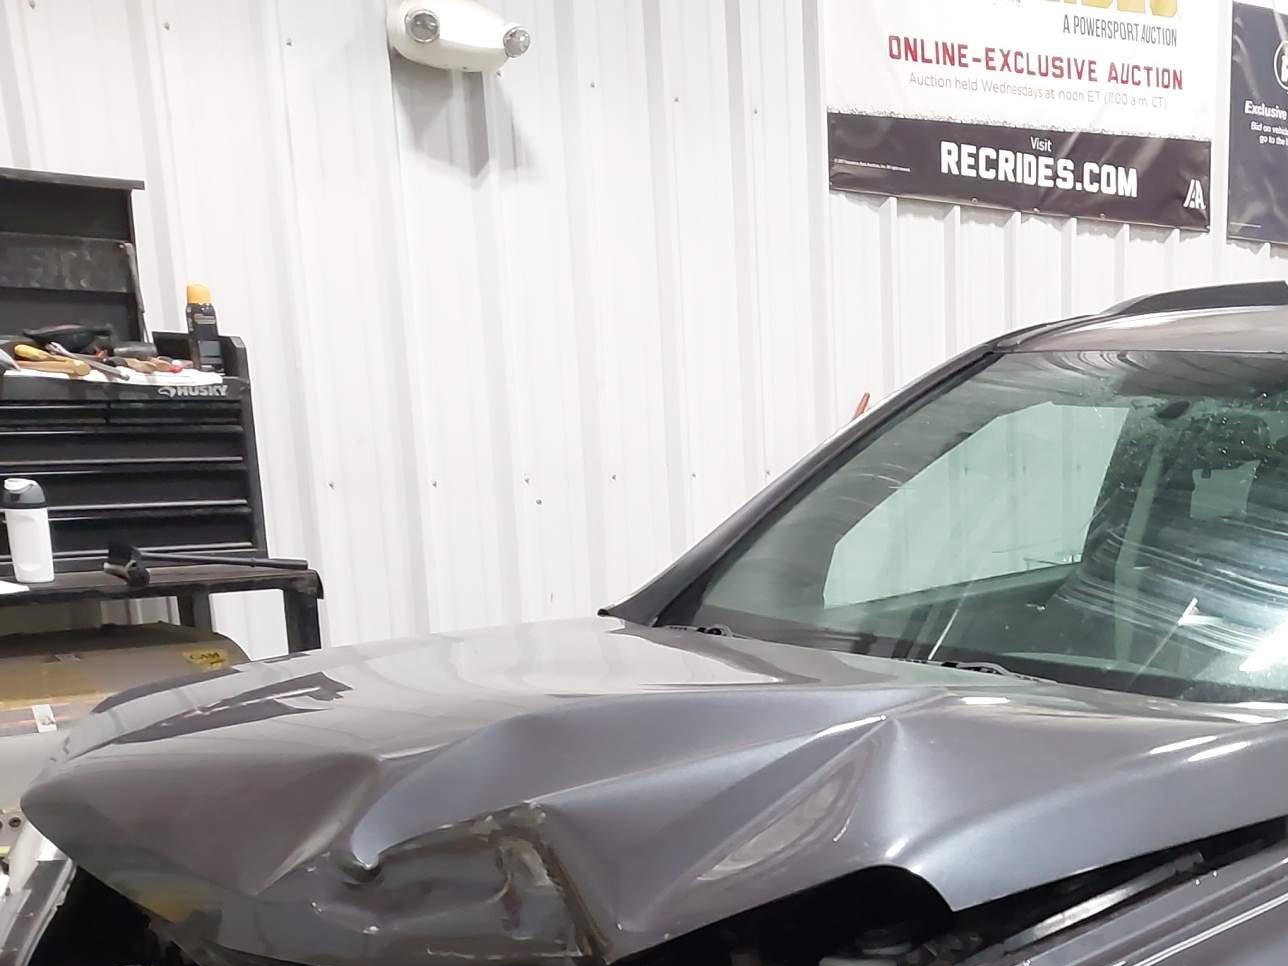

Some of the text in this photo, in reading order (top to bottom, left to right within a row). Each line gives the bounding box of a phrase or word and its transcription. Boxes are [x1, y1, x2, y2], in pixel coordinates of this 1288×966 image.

[1062, 13, 1178, 48] A POWERSPORT AUCTION
[888, 35, 1184, 91] ONLINE-EXCLUSIVE AUCTION
[908, 72, 953, 90] Auction
[955, 76, 978, 93] held
[981, 79, 1044, 100] Wednesdays
[1045, 87, 1056, 100] at
[1058, 90, 1085, 102] noon
[1244, 100, 1288, 121] Exclusive
[1250, 120, 1263, 132] Bid
[1030, 135, 1053, 152] Visit
[940, 140, 1138, 198] RECRIDES.COM
[177, 384, 228, 397] HUSKY
